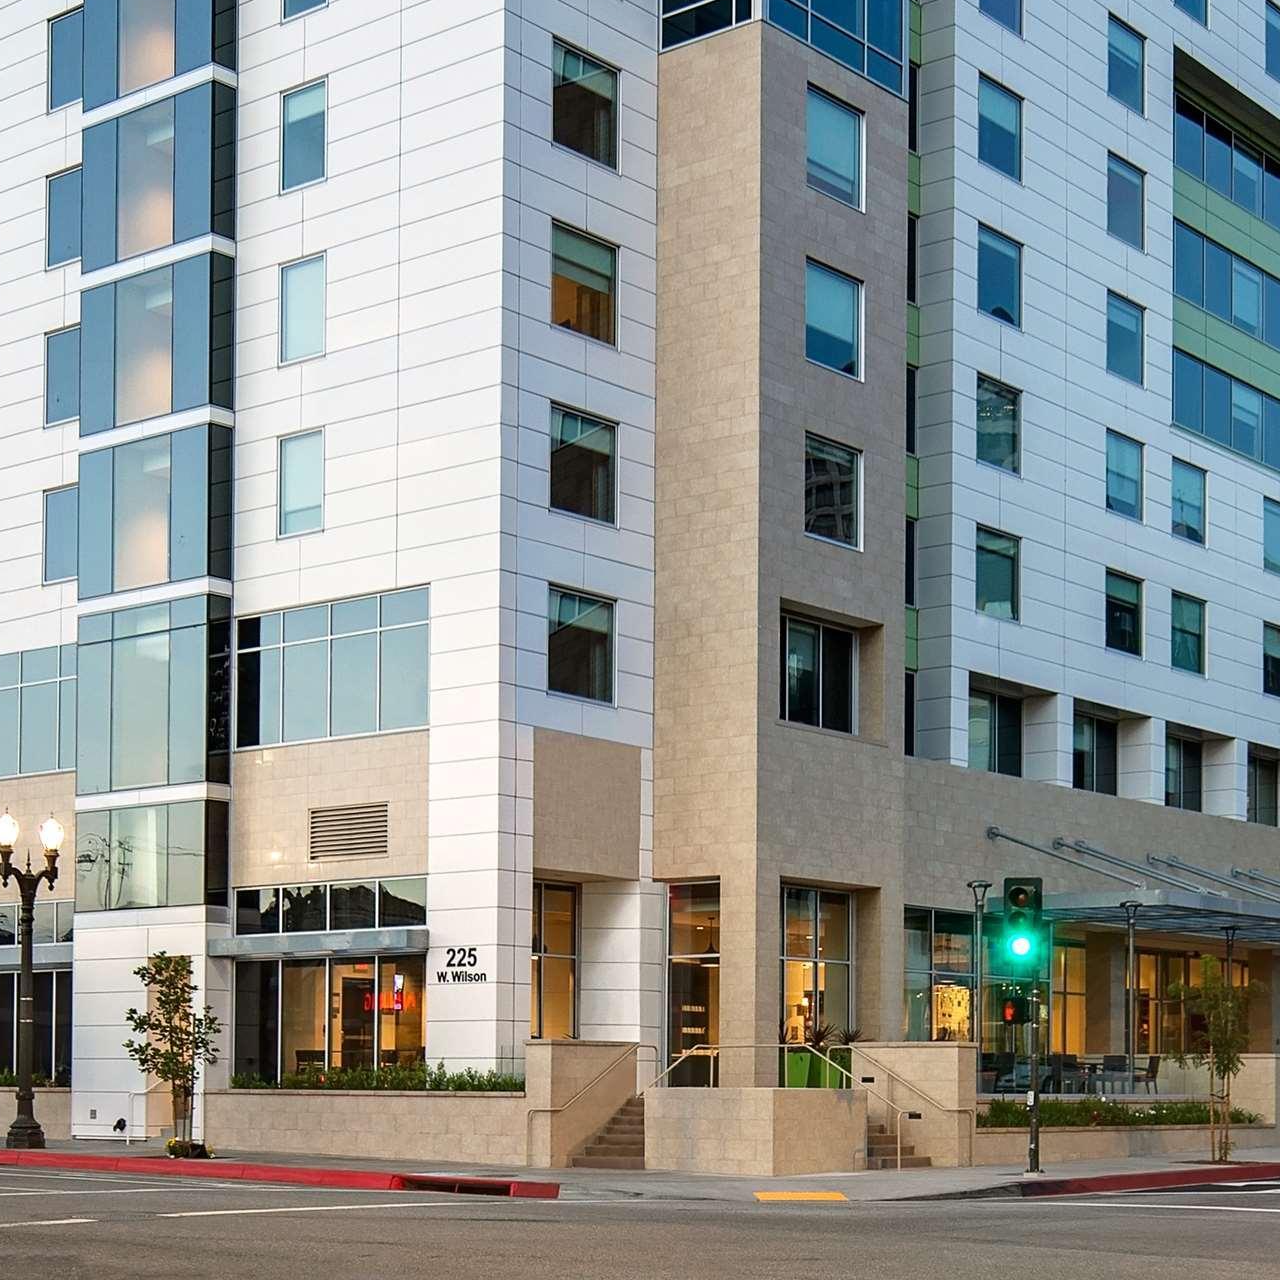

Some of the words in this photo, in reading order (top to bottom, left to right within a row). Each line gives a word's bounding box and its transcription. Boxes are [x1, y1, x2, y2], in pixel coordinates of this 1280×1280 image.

[446, 947, 478, 967] 225
[436, 970, 450, 983] W.
[451, 970, 487, 983] Wilson
